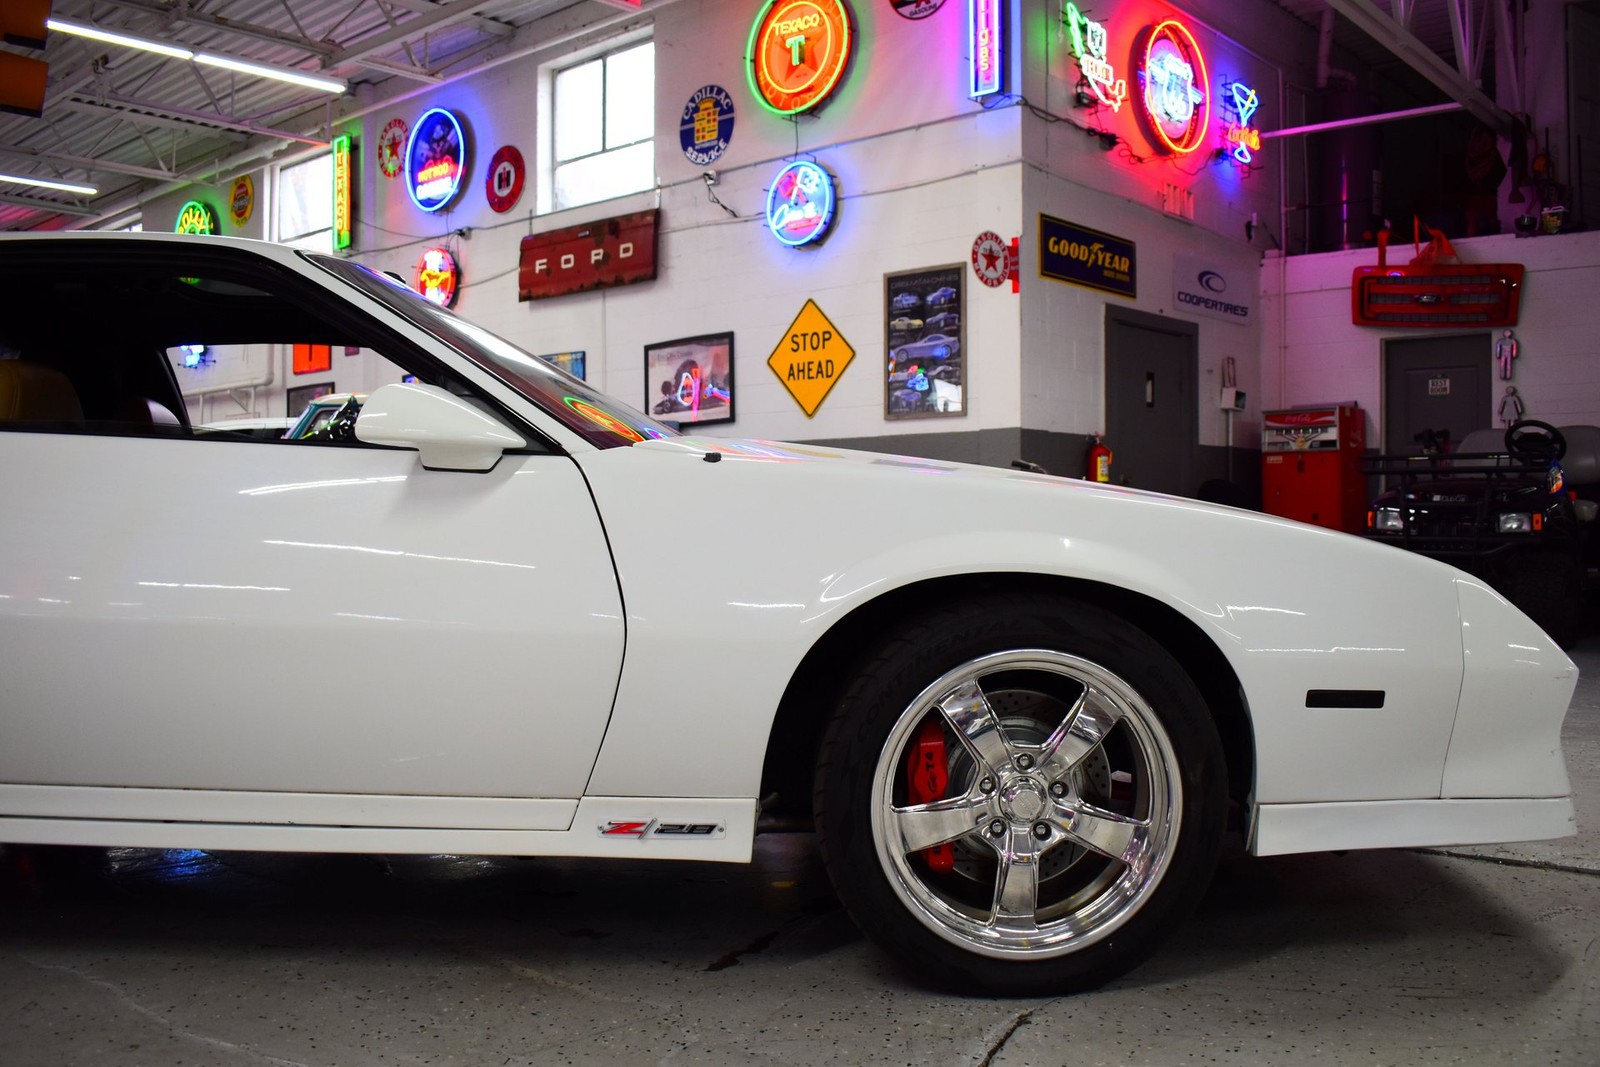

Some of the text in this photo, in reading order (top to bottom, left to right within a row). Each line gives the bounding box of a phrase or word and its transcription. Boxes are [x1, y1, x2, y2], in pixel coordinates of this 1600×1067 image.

[908, 3, 938, 17] GASOLINE
[772, 13, 820, 36] TEXACO
[683, 86, 732, 120] CADILLAC
[685, 138, 727, 164] SERVICE
[336, 152, 345, 231] TEXACO
[535, 242, 634, 274] FORD
[791, 330, 832, 352] STOP
[787, 359, 834, 381] AHEAD
